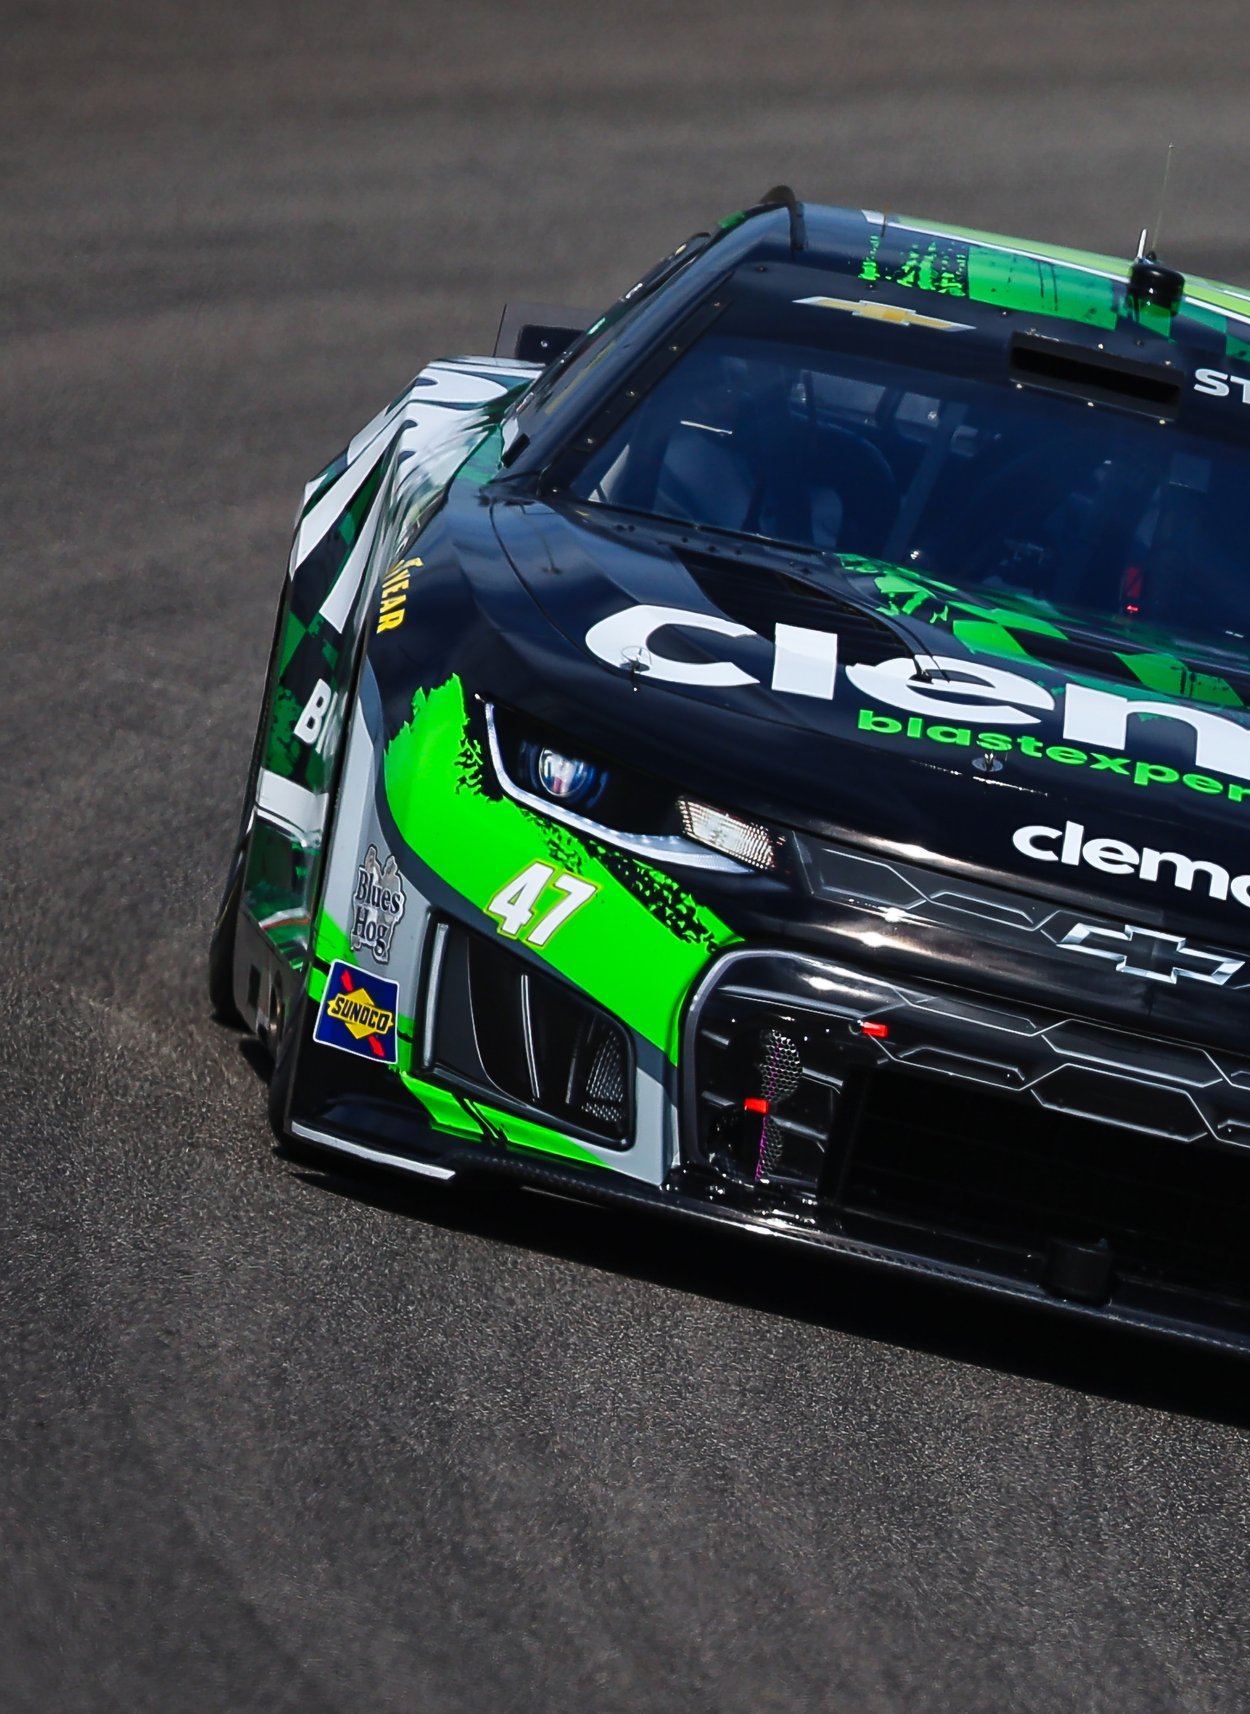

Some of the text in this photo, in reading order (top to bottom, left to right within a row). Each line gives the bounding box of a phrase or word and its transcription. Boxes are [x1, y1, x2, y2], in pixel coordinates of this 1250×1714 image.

[355, 870, 402, 915] Blues
[487, 862, 597, 946] 47
[352, 905, 389, 956] Hog
[331, 996, 390, 1032] SUNOCO
